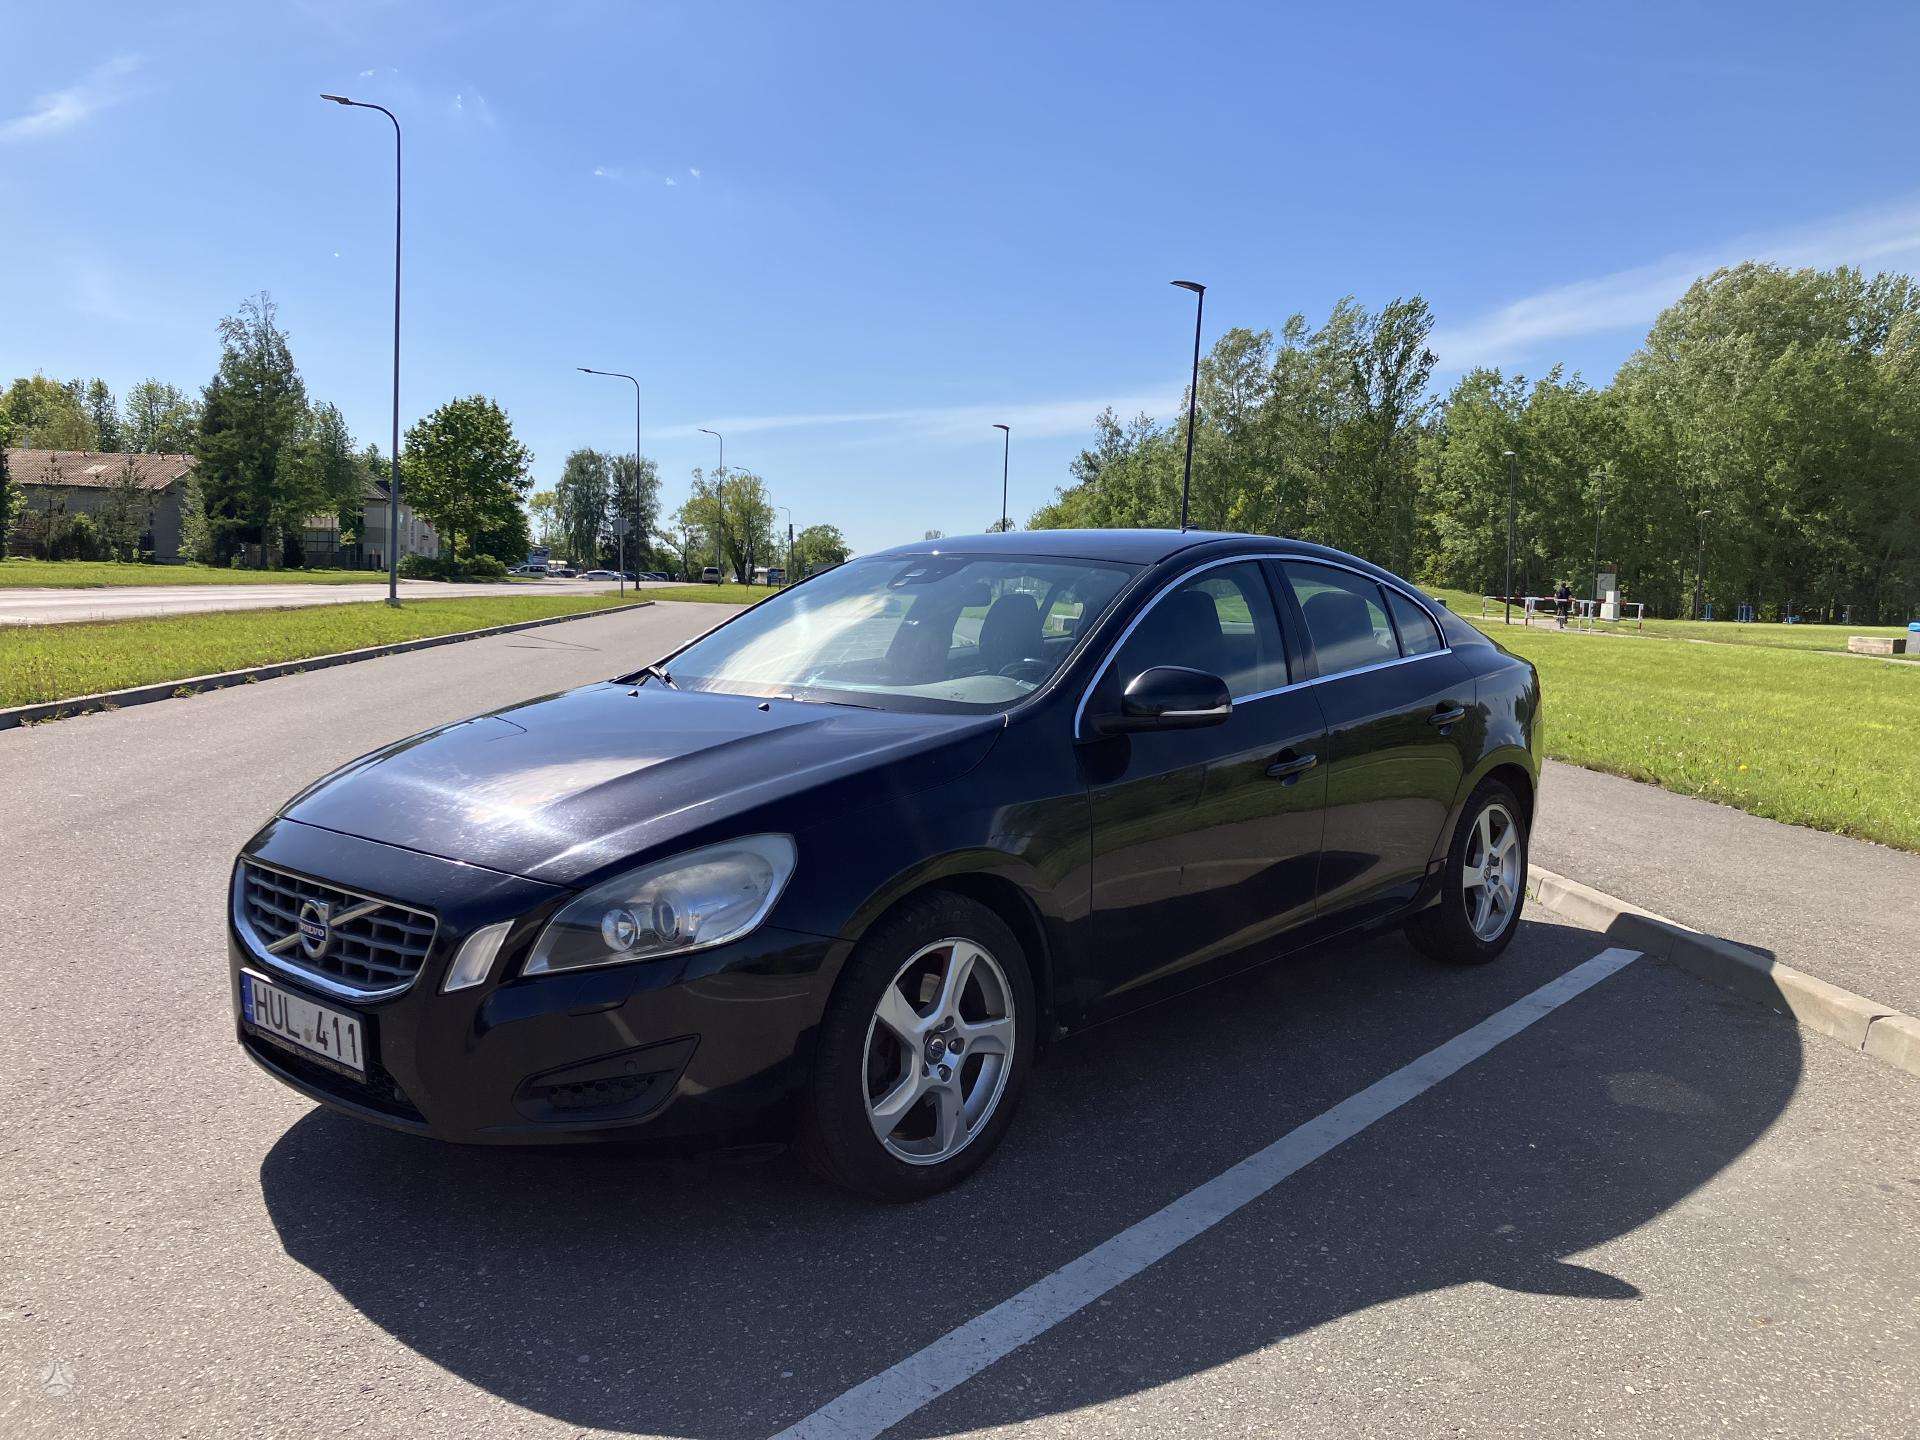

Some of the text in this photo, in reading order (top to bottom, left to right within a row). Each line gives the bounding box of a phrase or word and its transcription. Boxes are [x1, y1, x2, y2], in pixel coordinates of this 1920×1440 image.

[300, 922, 325, 937] VOLVO
[253, 983, 300, 1040] HUL
[316, 1011, 357, 1064] 411
